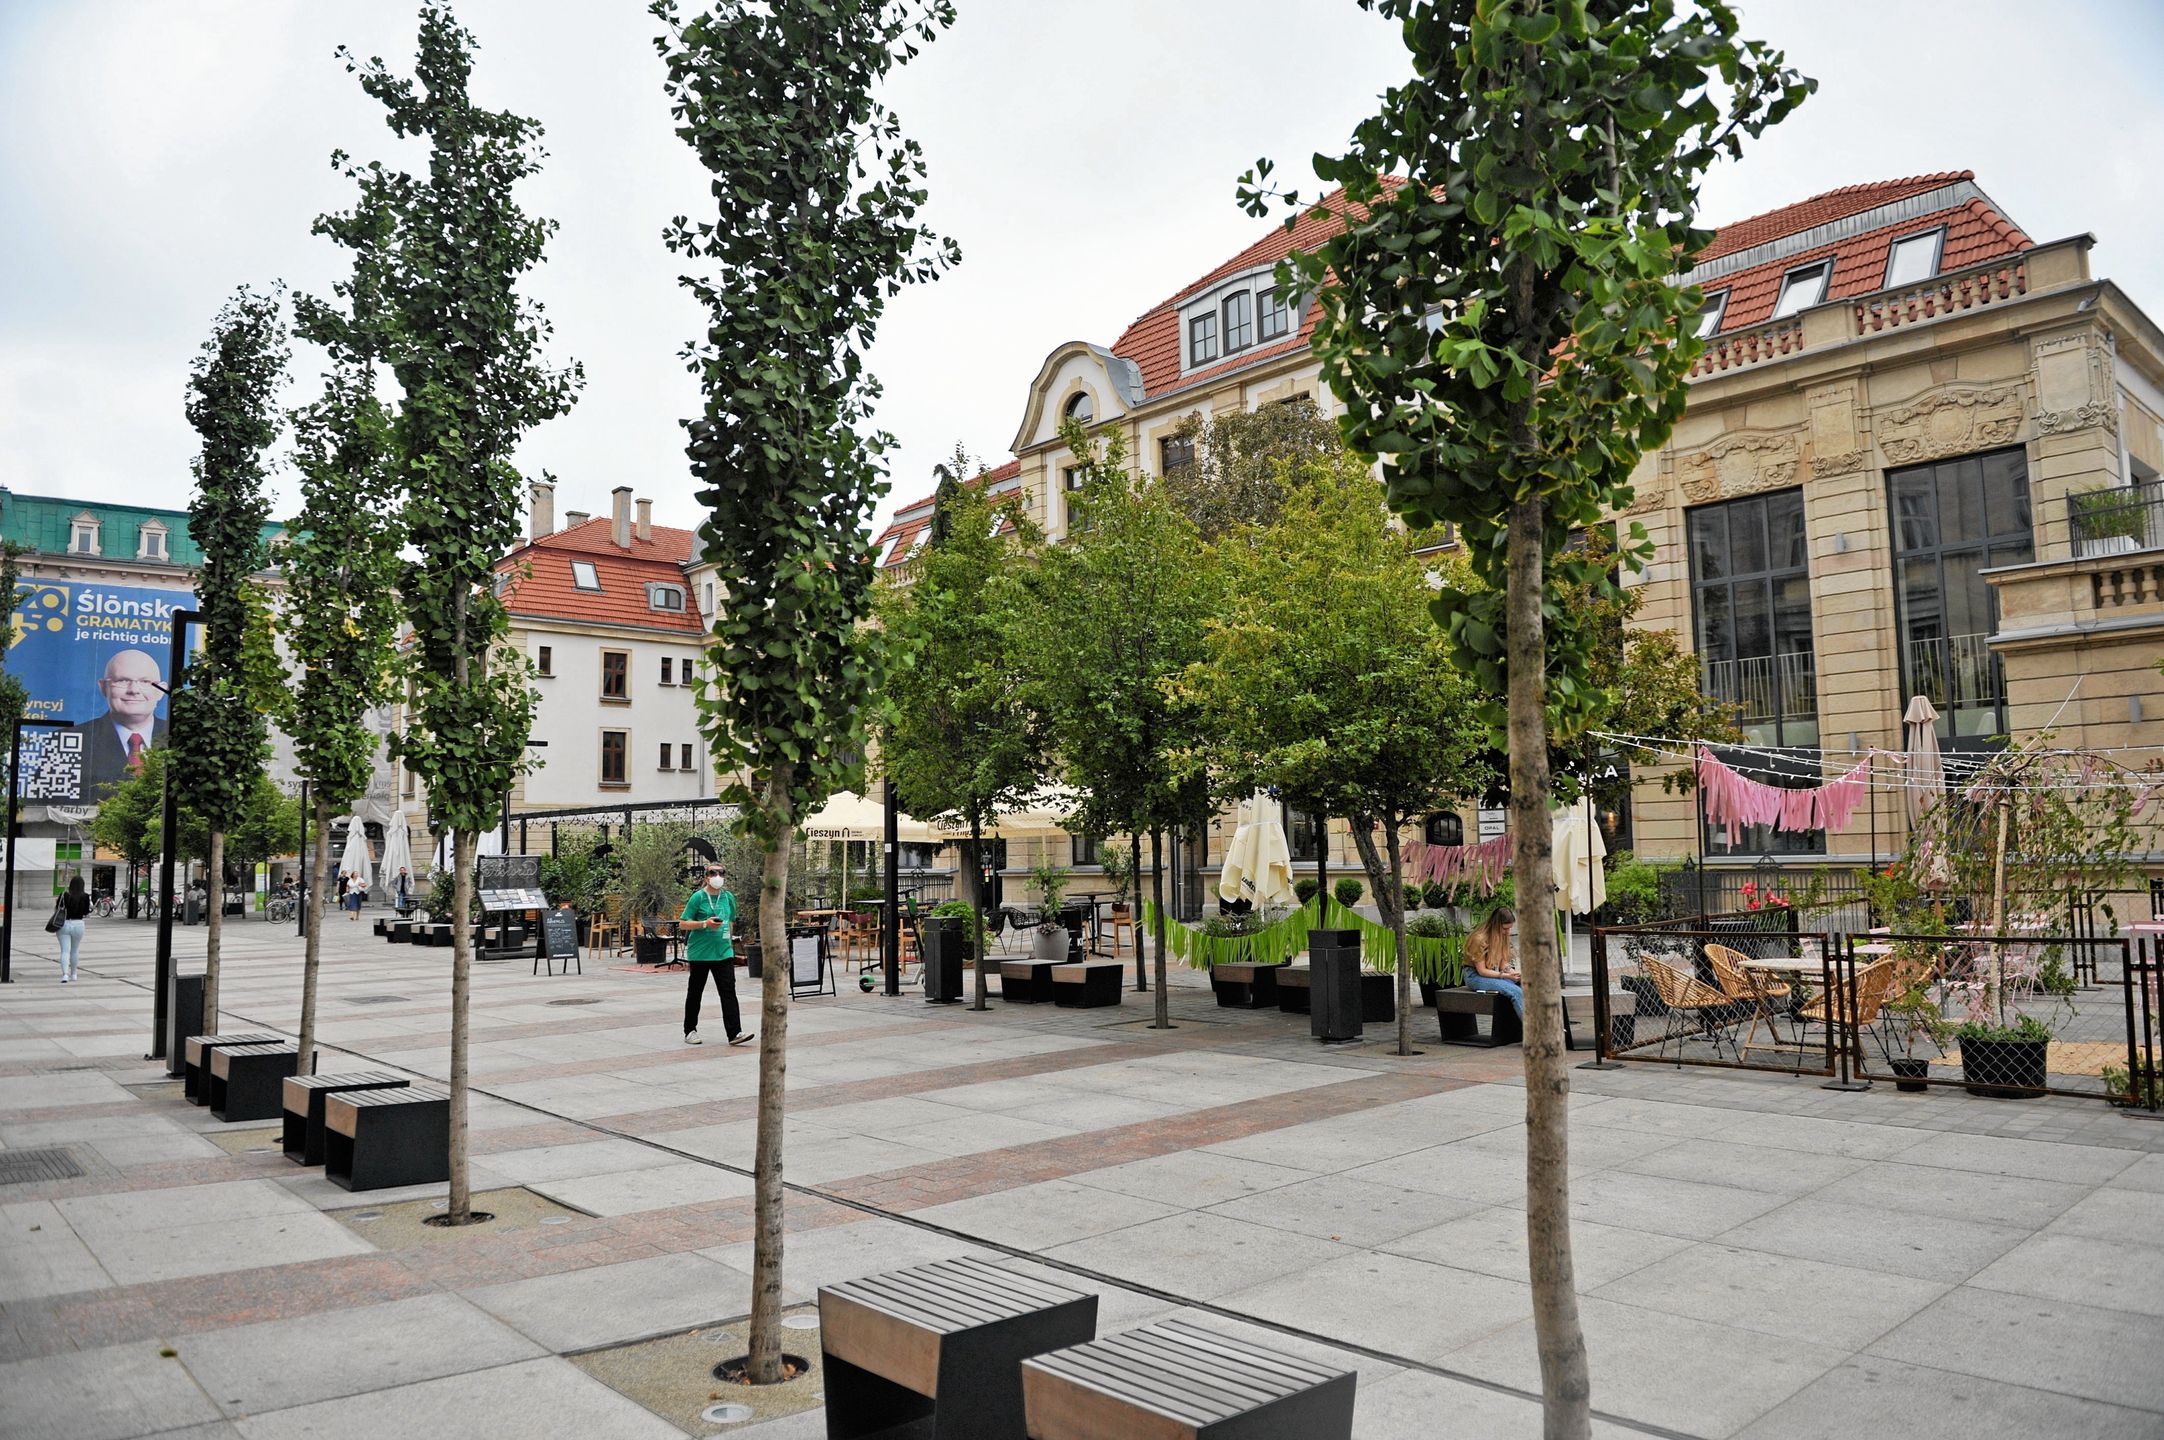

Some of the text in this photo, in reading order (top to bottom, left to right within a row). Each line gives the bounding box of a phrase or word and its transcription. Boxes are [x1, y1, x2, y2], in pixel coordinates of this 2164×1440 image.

[75, 629, 90, 641] je
[93, 630, 138, 644] richtig
[806, 827, 840, 839] Cieszyn
